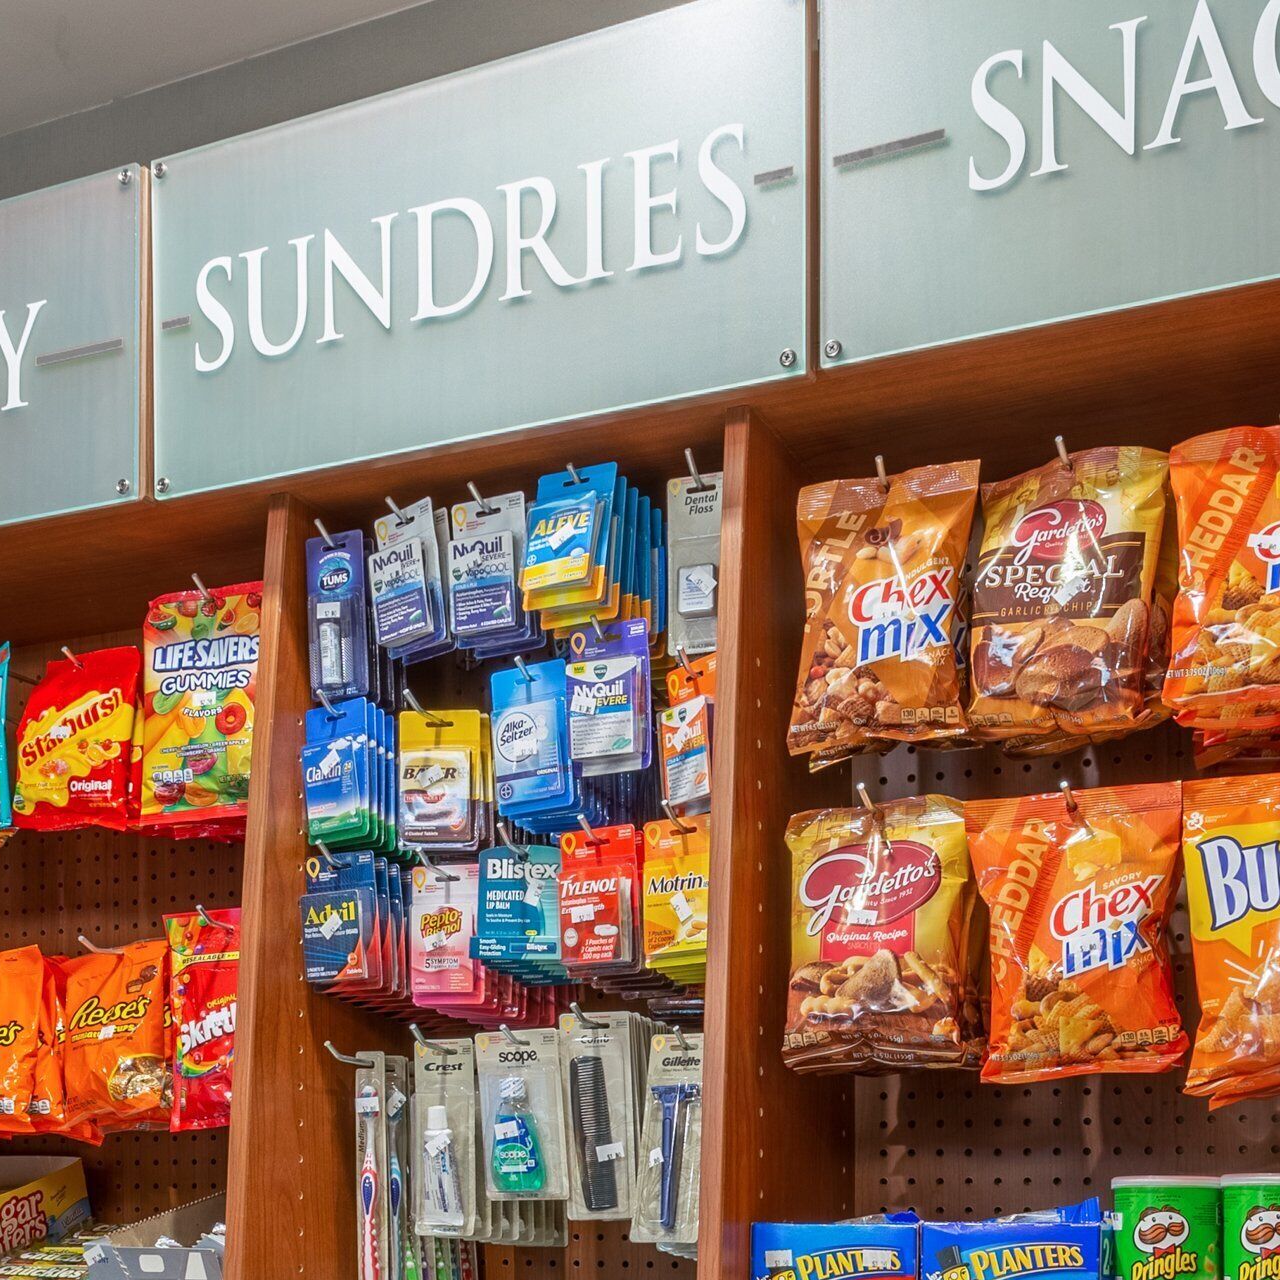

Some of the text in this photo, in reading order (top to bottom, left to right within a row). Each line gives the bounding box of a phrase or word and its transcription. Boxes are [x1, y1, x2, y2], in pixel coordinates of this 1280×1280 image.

[194, 123, 748, 373] SUNDRIES
[684, 493, 718, 507] Dental
[689, 503, 714, 515] Floss
[1180, 447, 1266, 589] CHEDDAR
[322, 572, 348, 585] TUMS
[850, 567, 954, 625] Chex
[1001, 605, 1041, 617] GARLIC
[857, 604, 951, 666] mix
[161, 671, 251, 695] GUMMIES
[183, 707, 222, 718] FLAVORS
[503, 720, 528, 735] Alka-
[500, 727, 534, 746] Seltzer
[70, 780, 112, 792] Original
[487, 859, 558, 880] Blistex
[561, 877, 618, 898] TYLENOL
[648, 873, 703, 895] Motrin
[487, 890, 524, 901] MEDICATED
[486, 901, 495, 909] LIP
[420, 911, 462, 930] Pepto-
[826, 927, 908, 944] Original Recipe
[70, 997, 151, 1031] Reese's
[499, 1050, 537, 1065] scope
[662, 1057, 701, 1067] Gillette
[425, 1062, 462, 1072] Crest
[358, 1121, 367, 1153] Medium
